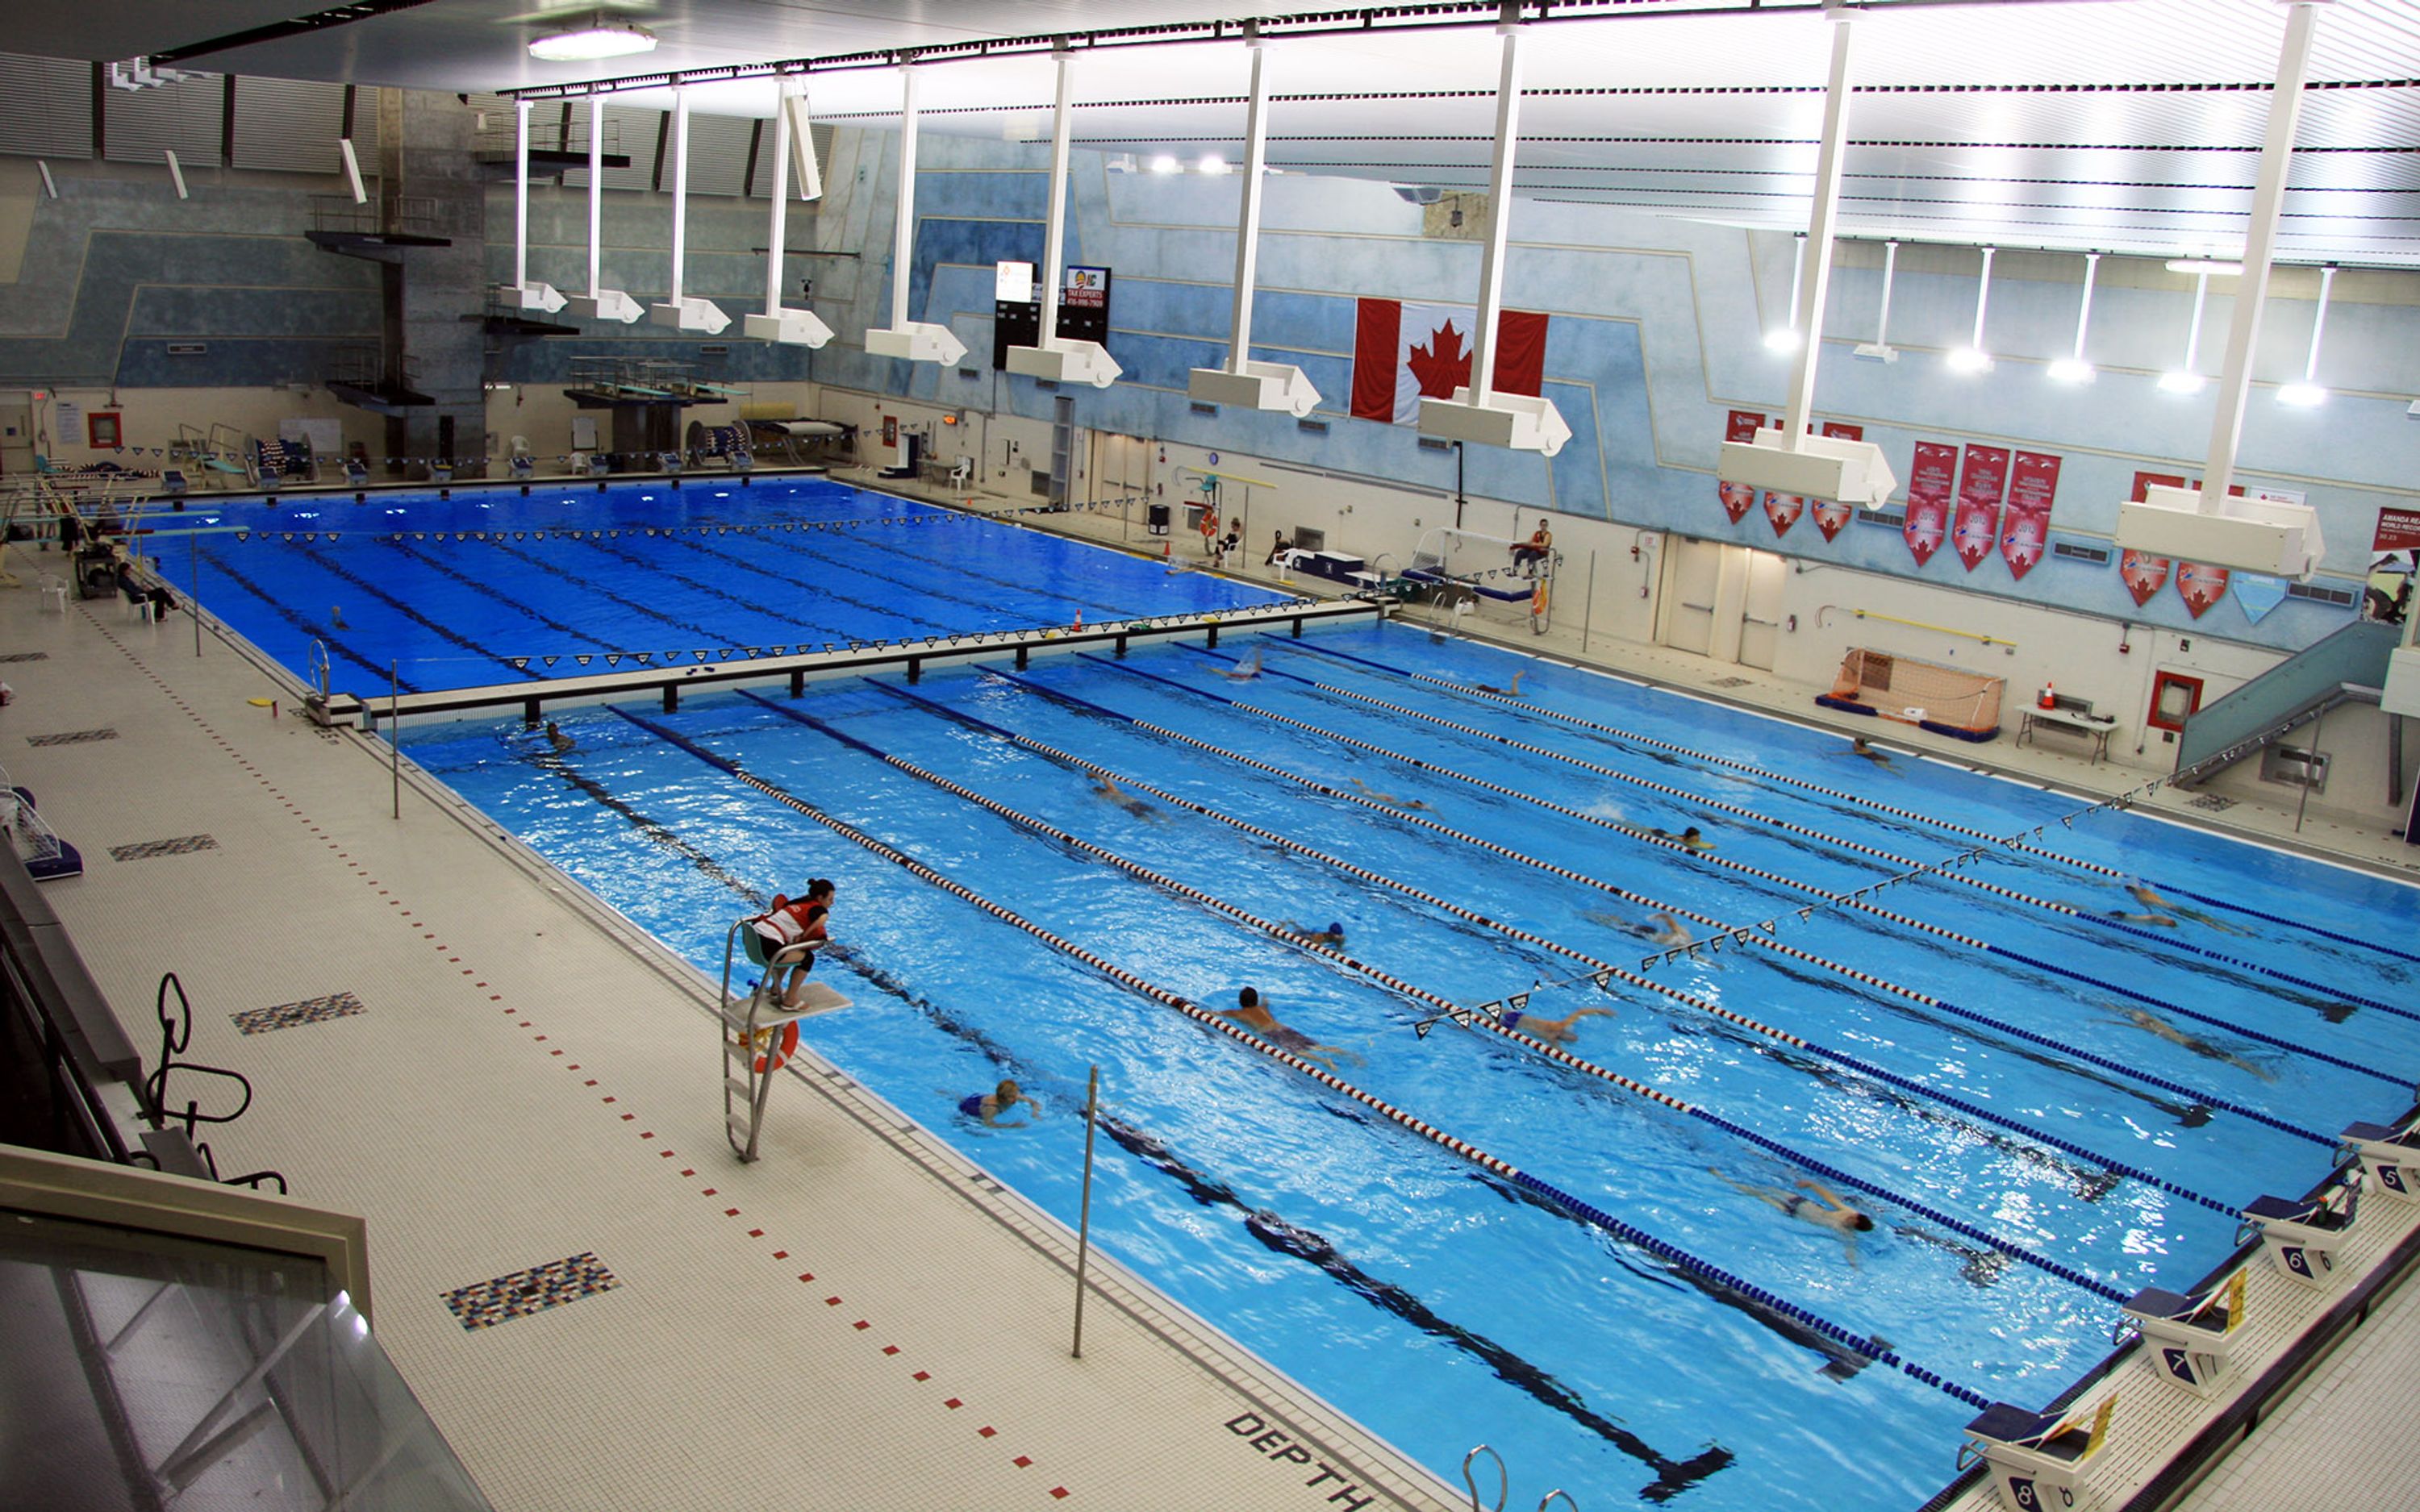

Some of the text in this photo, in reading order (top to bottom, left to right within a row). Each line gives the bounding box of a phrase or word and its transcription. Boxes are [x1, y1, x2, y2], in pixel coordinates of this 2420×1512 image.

[2385, 1171, 2397, 1185] 5
[2289, 1252, 2301, 1268] 6
[2319, 1250, 2332, 1272] 6
[2172, 1353, 2185, 1371] 7
[1224, 1411, 1375, 1512] DEPTH
[2018, 1485, 2032, 1505] 8
